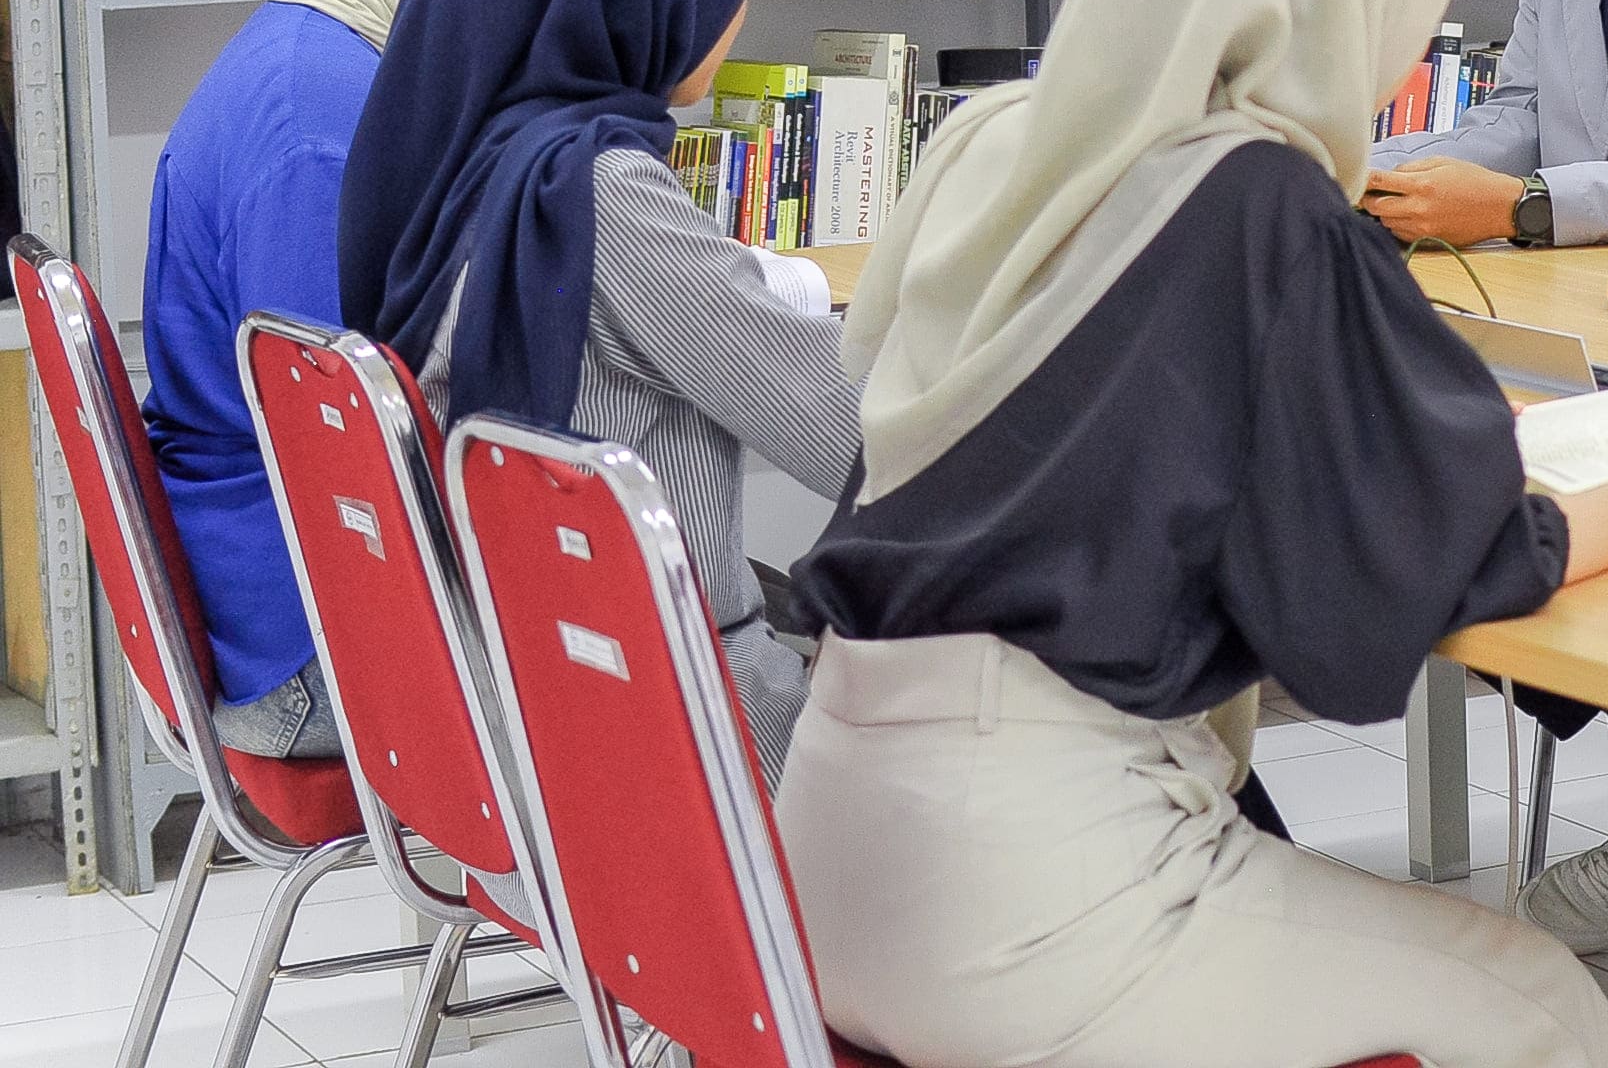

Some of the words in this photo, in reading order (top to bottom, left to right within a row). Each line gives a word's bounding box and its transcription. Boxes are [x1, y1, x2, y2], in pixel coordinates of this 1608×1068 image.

[832, 130, 845, 204] Architecture
[846, 131, 858, 163] Revit
[857, 126, 874, 238] MASTERING
[830, 206, 842, 234] 2008
